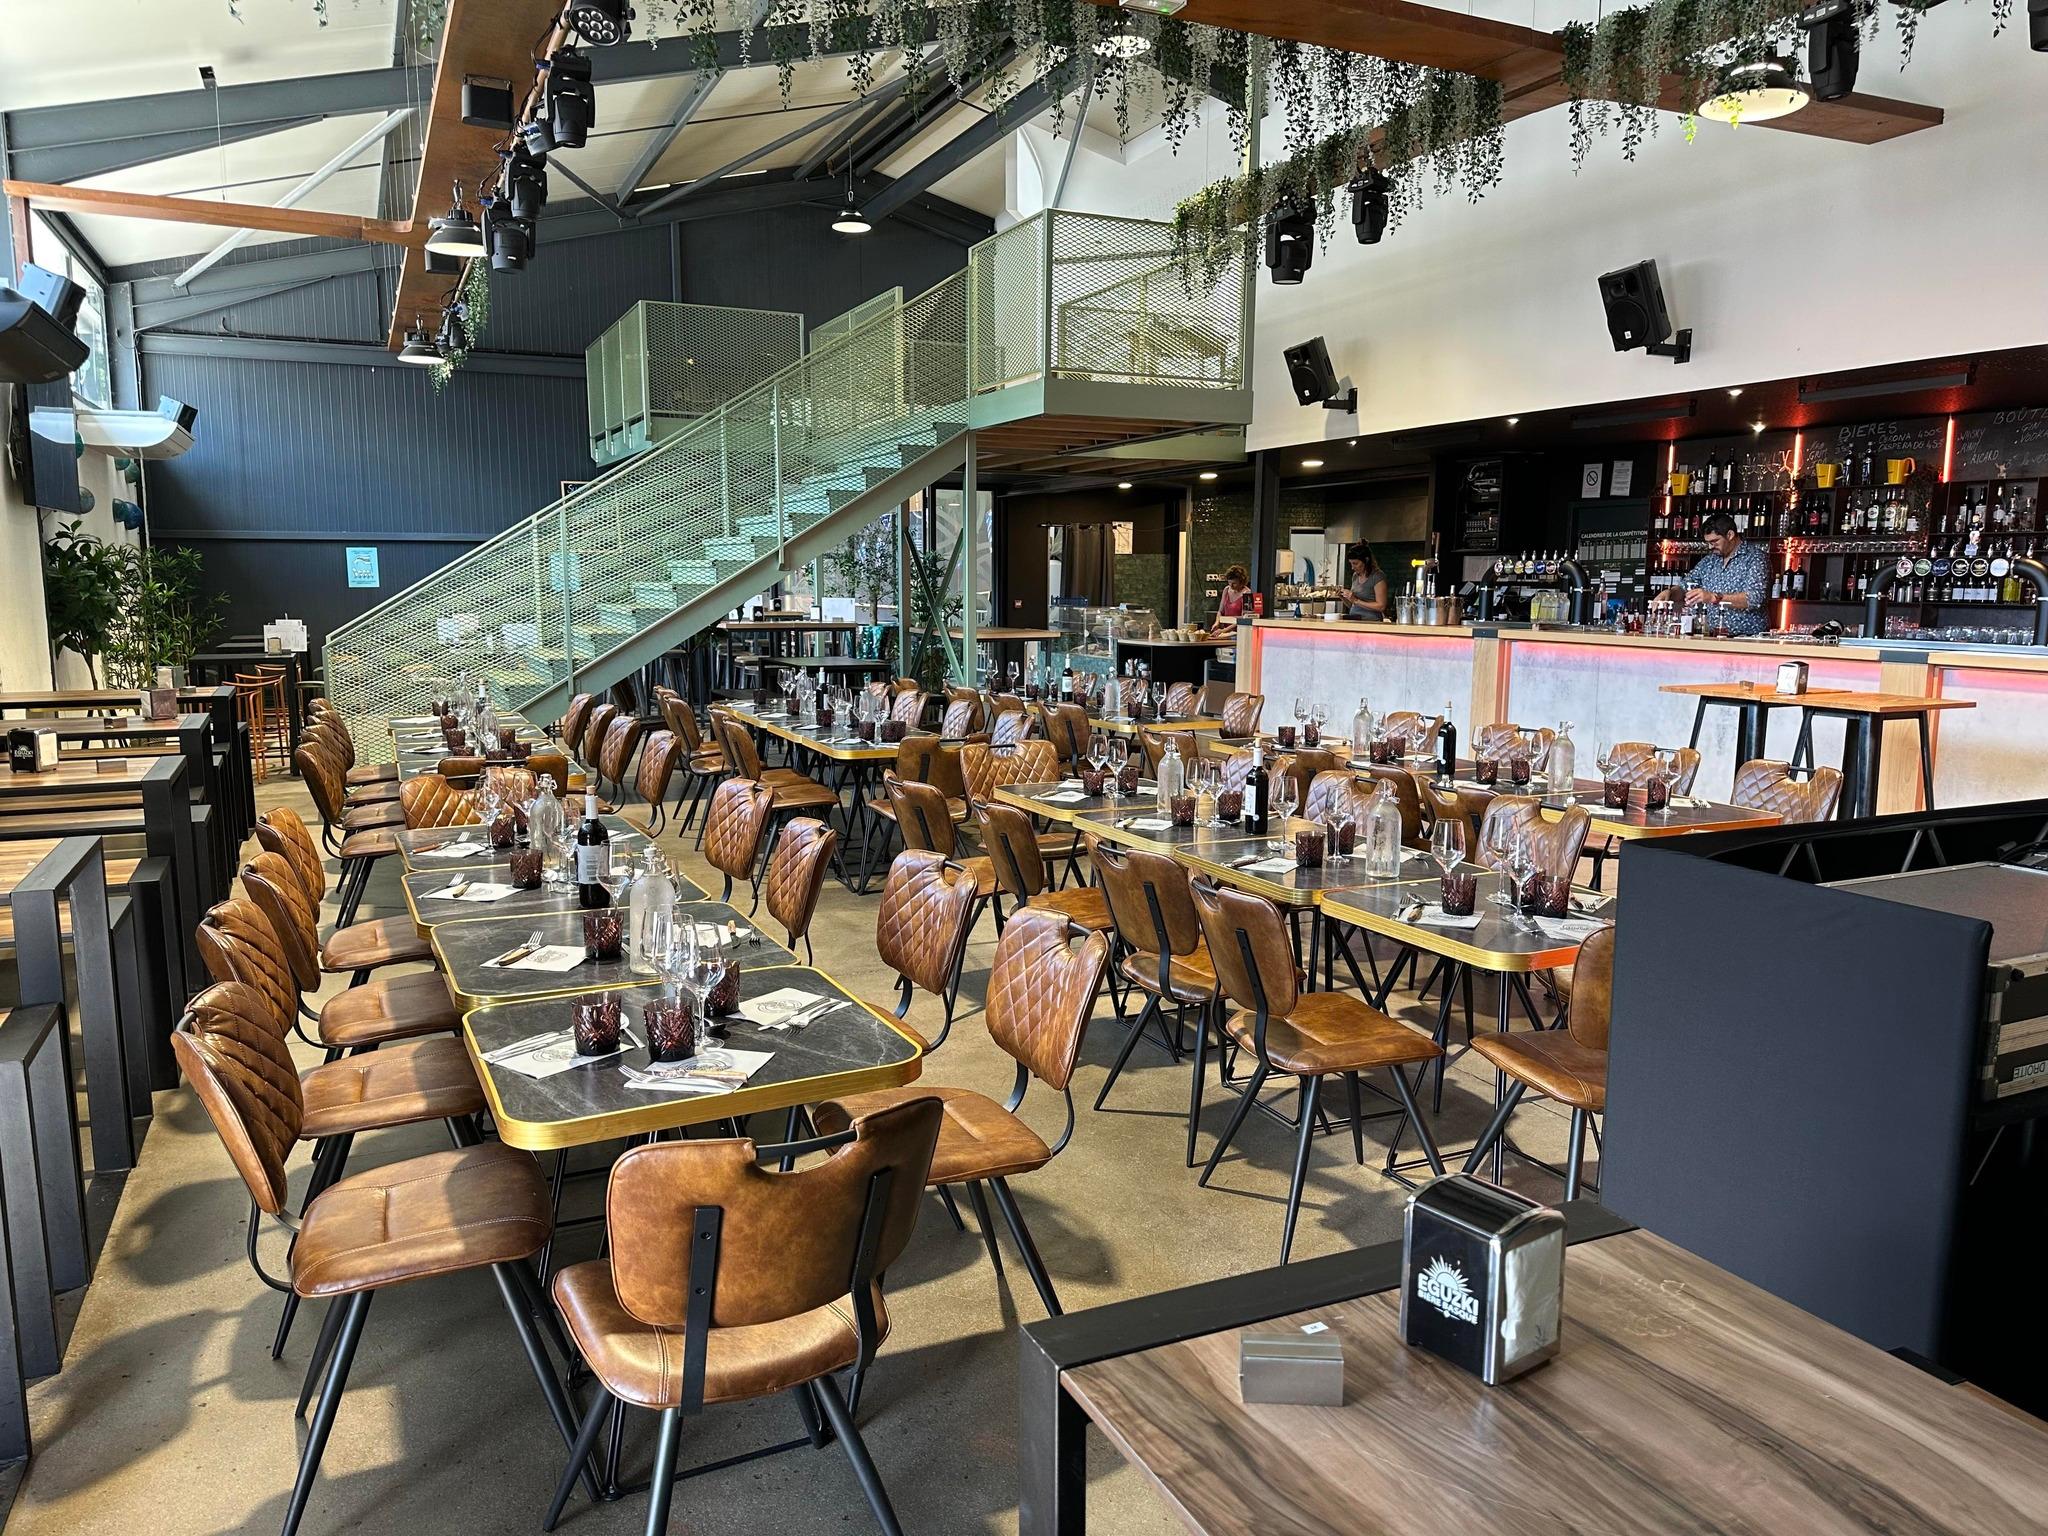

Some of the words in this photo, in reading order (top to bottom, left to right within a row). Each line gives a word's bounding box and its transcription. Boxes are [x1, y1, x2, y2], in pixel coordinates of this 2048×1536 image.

[1839, 422, 1898, 438] BIERES
[2014, 1062, 2046, 1079] DROITE
[1417, 1272, 1479, 1316] EGUZKI
[1442, 1301, 1478, 1325] BASQUE
